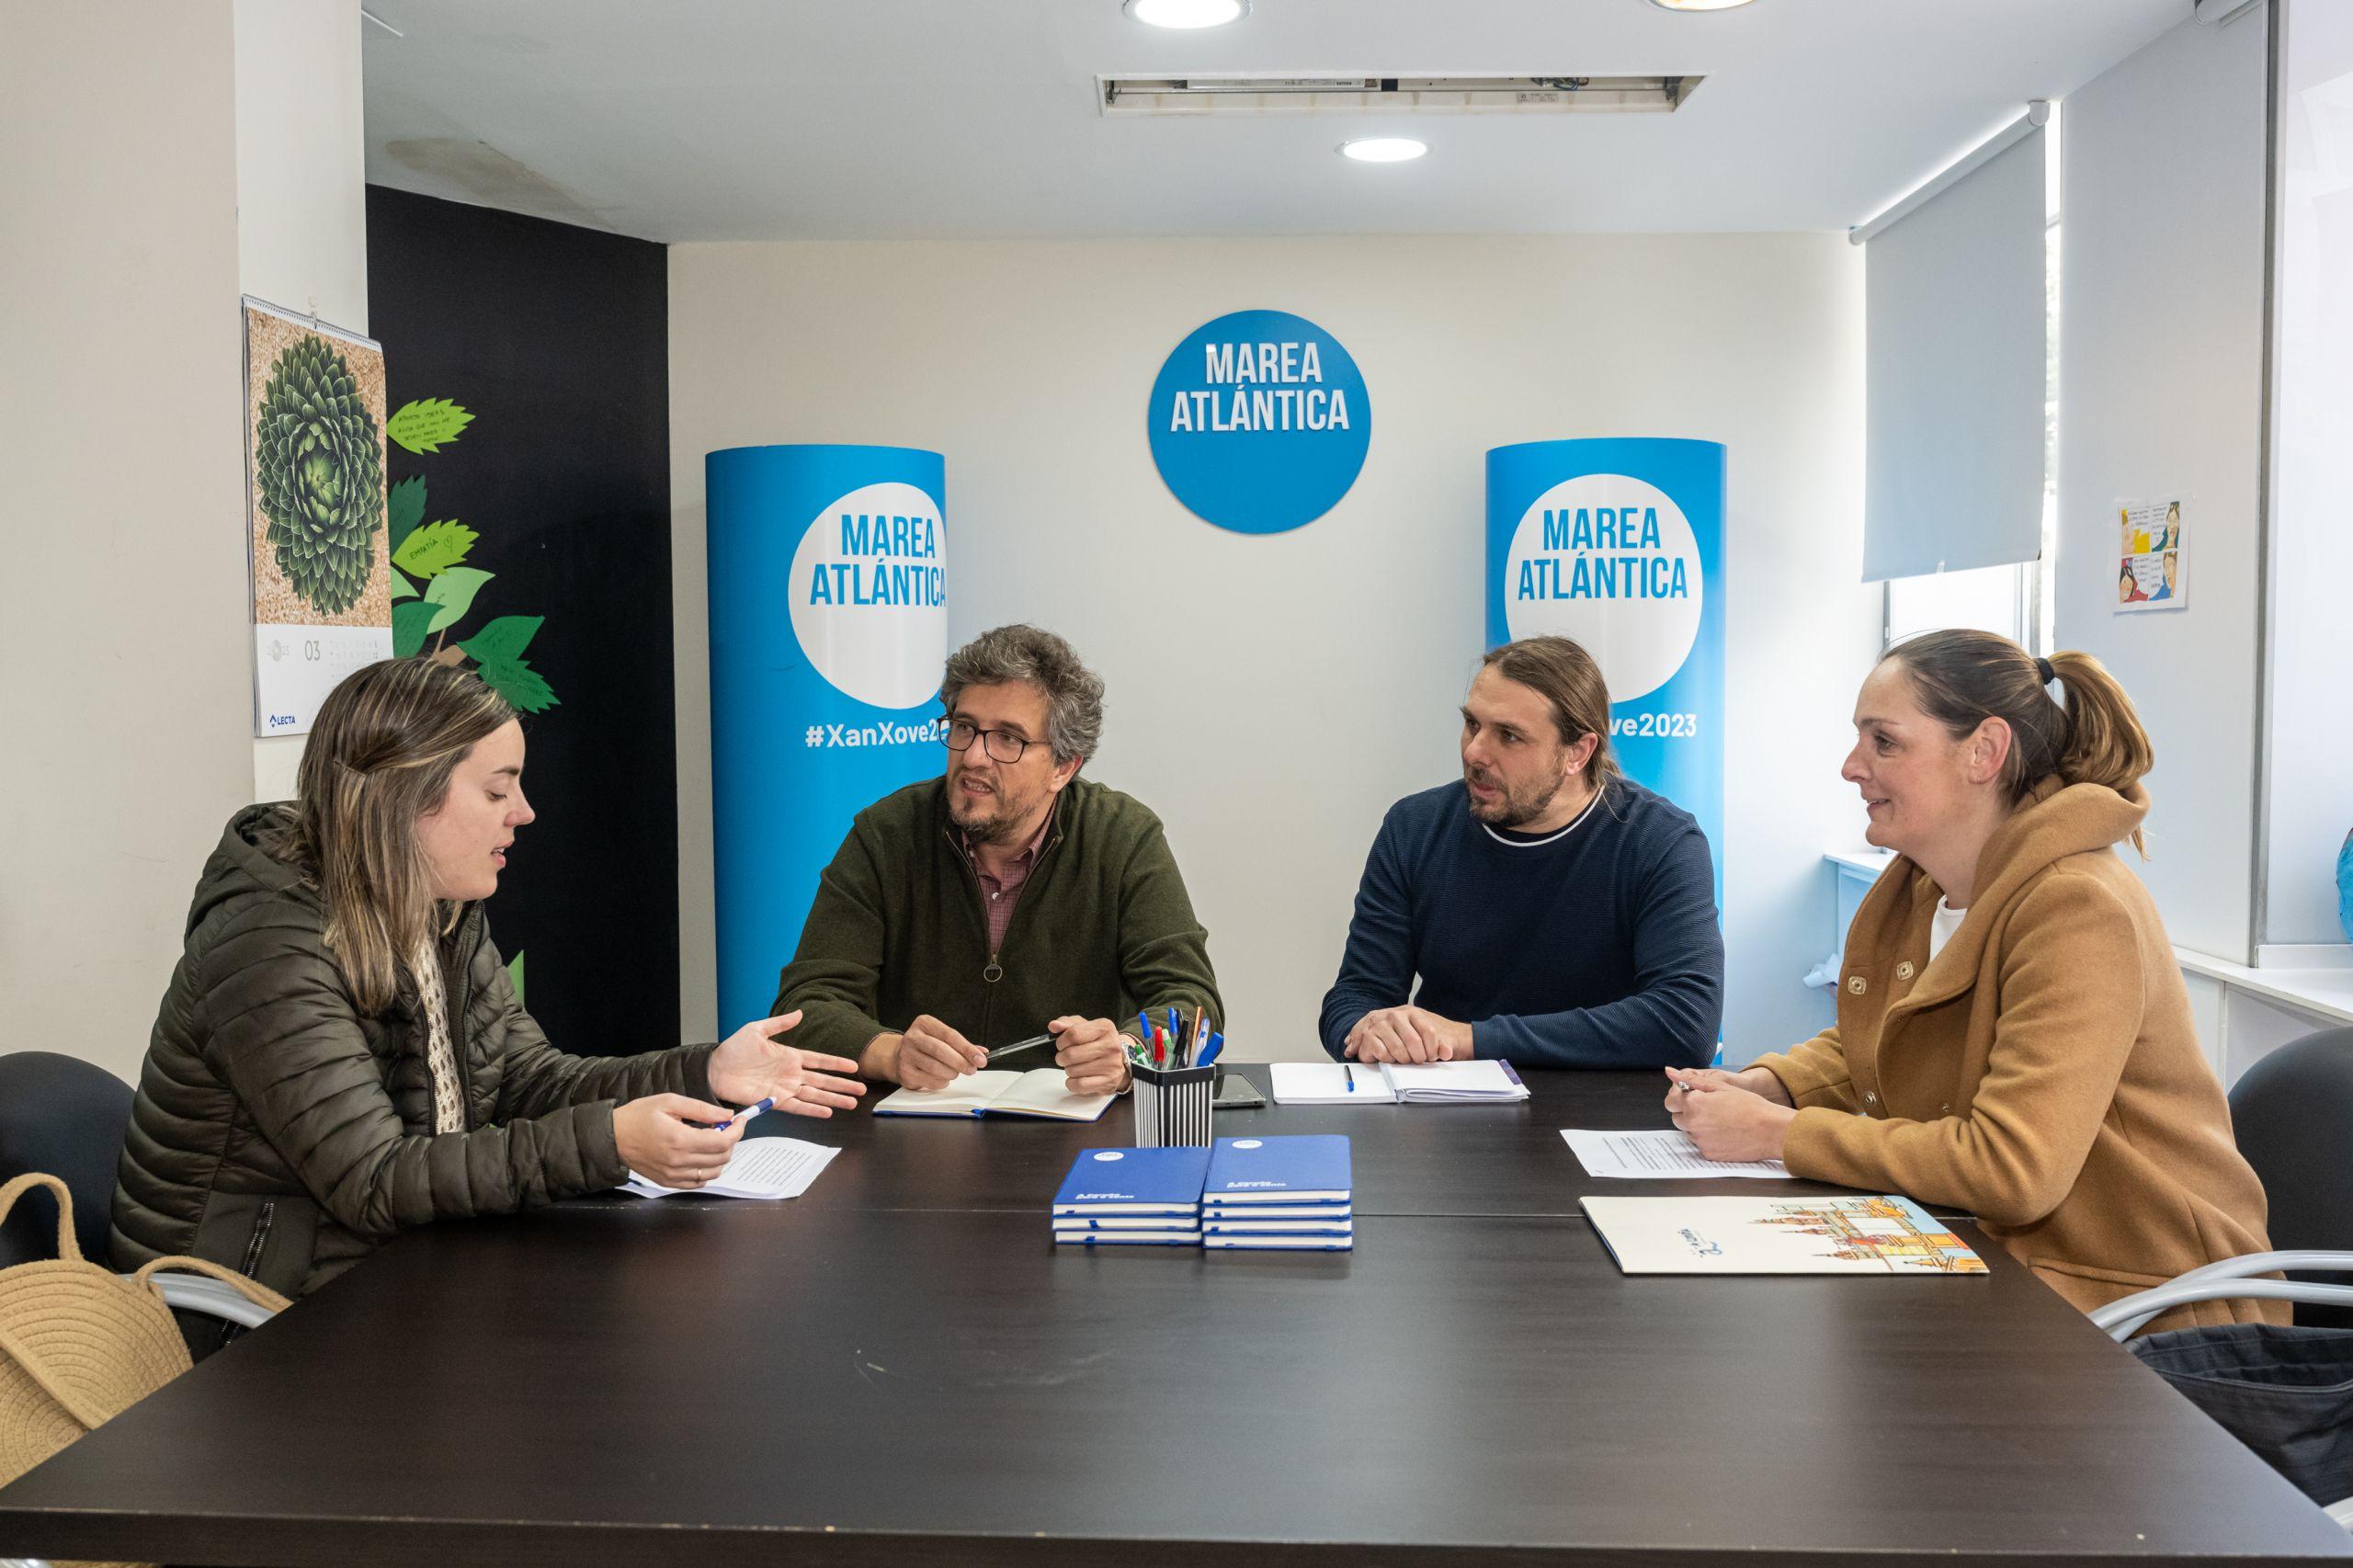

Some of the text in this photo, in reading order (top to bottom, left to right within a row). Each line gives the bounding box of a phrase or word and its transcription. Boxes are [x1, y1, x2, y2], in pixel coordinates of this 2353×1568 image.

[1205, 342, 1323, 385] MAREA
[1170, 384, 1350, 433] ATLÁNTICA
[840, 514, 936, 558] MAREA
[1542, 507, 1662, 551] MAREA
[809, 558, 947, 607] ATLÁNTICA
[1518, 551, 1688, 601] ATLÁNTICA
[304, 640, 321, 662] 03
[277, 715, 296, 725] LECTA
[1609, 712, 1698, 737] ve2023
